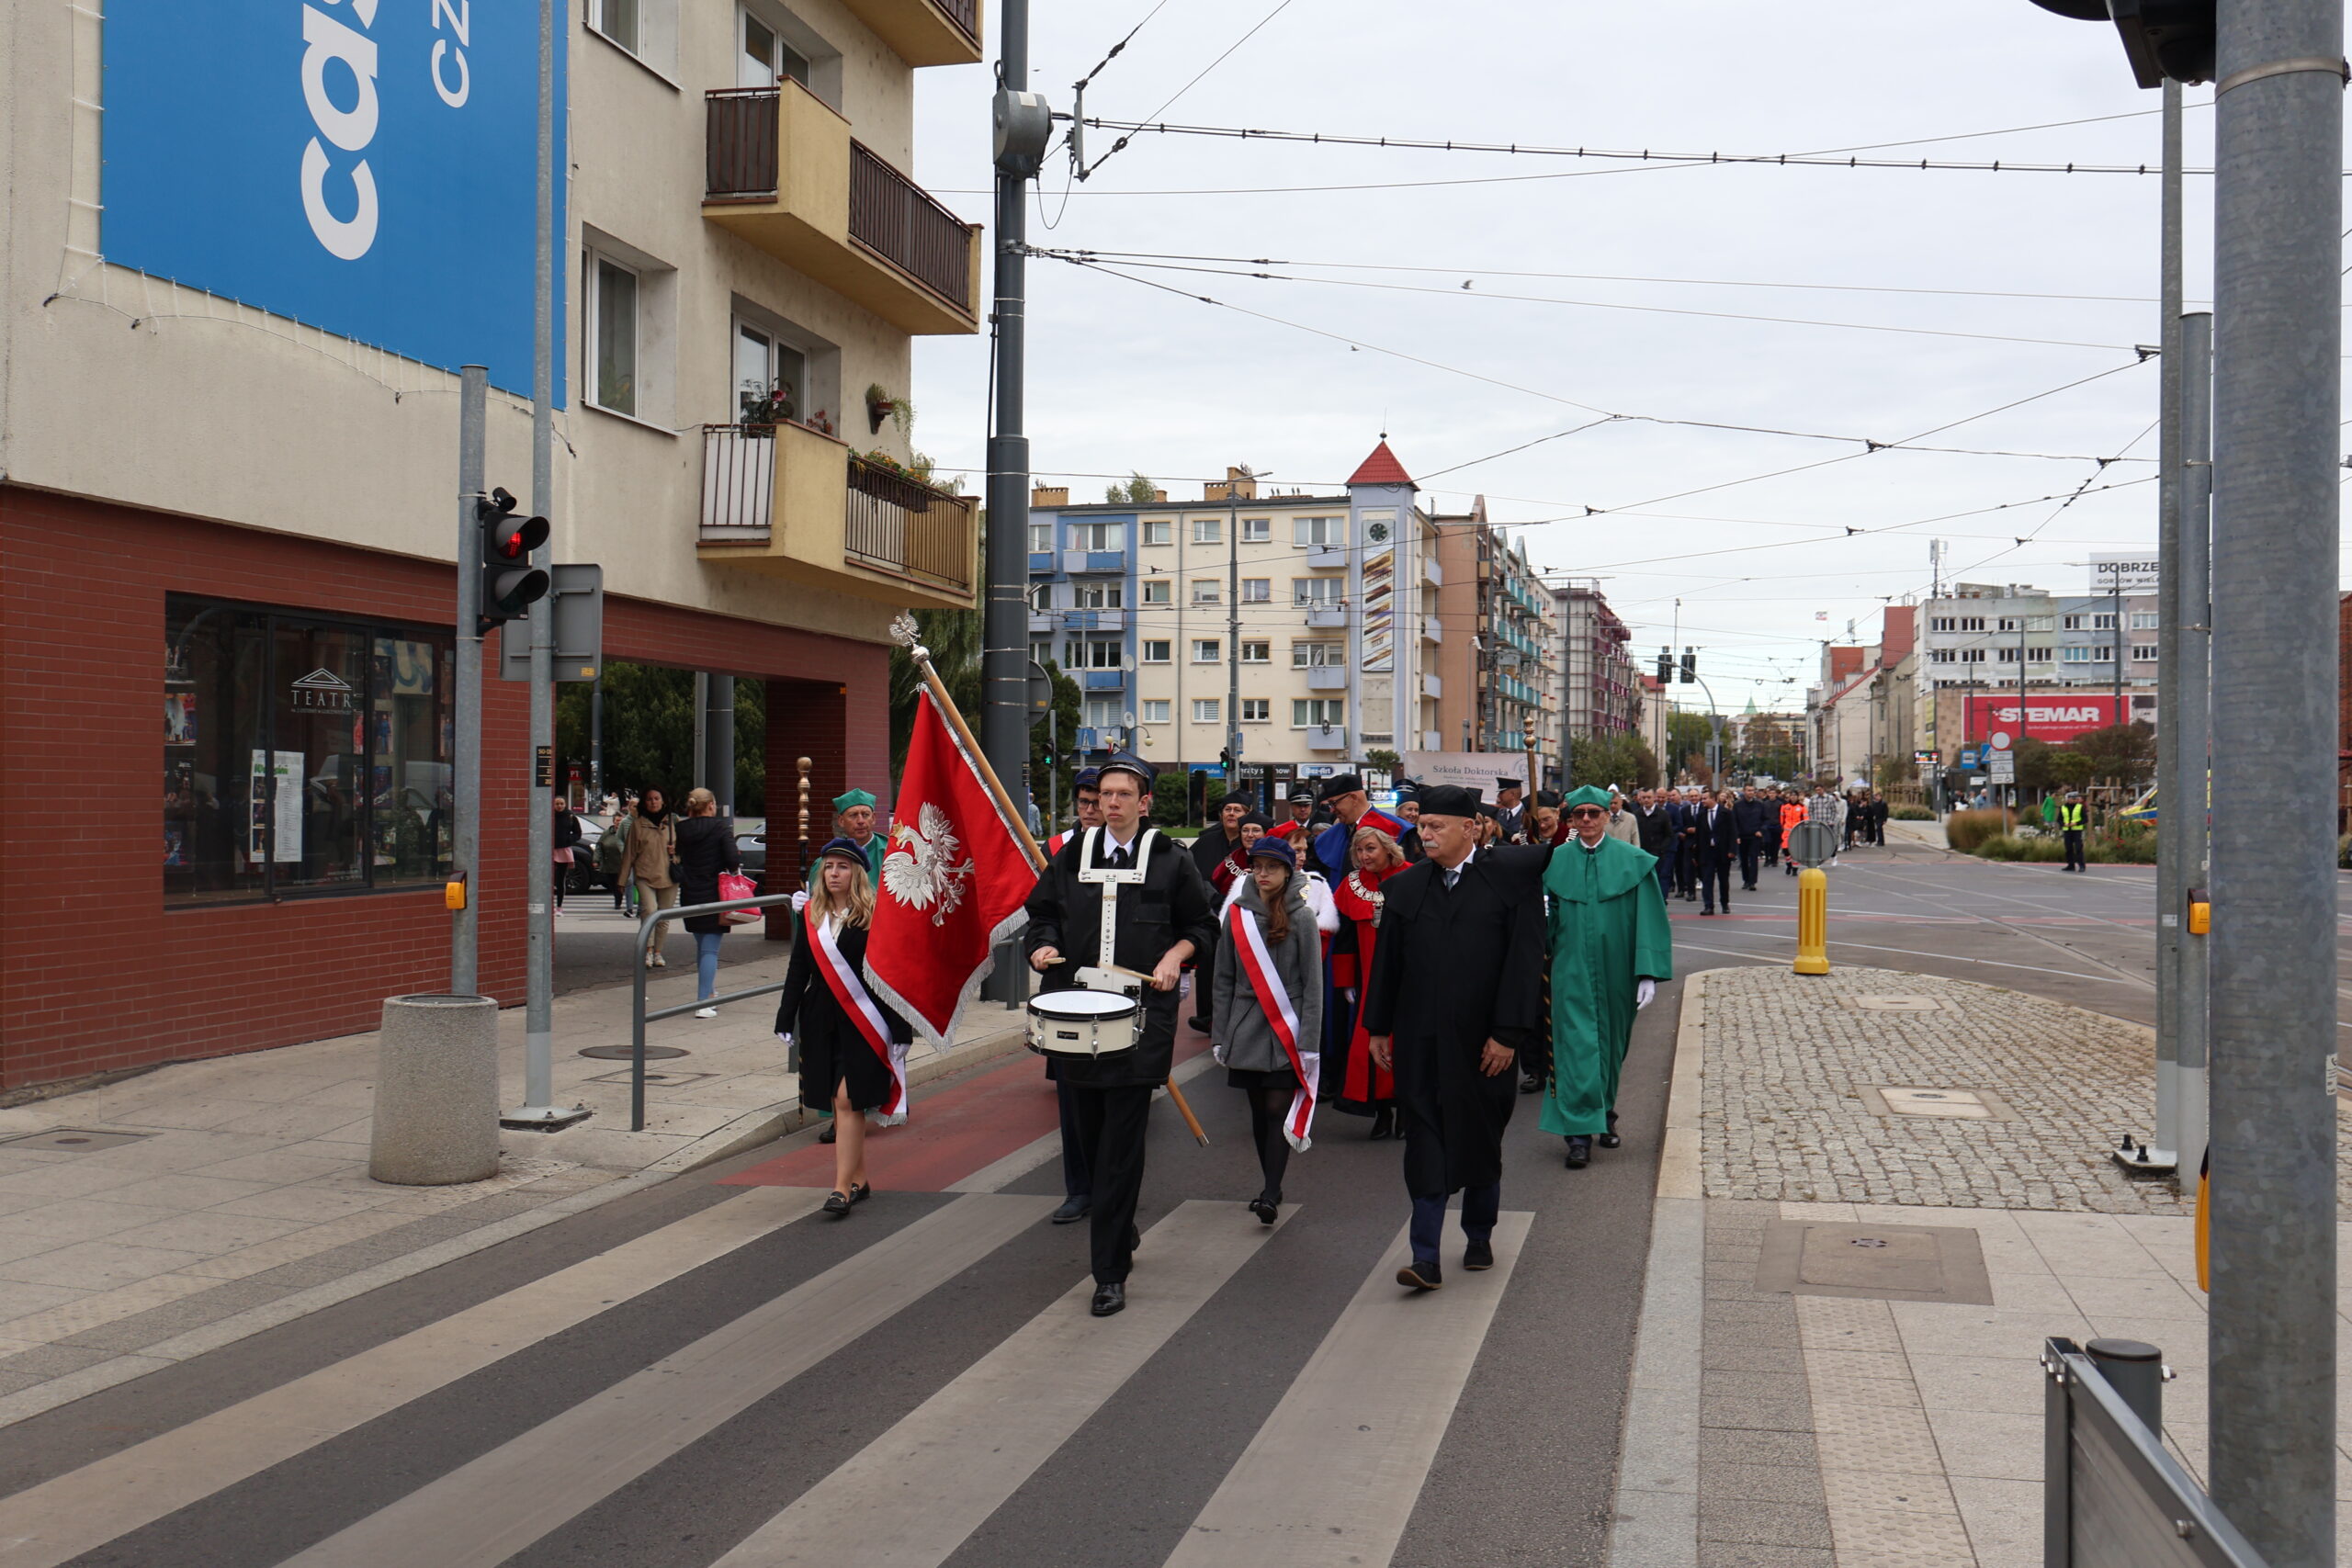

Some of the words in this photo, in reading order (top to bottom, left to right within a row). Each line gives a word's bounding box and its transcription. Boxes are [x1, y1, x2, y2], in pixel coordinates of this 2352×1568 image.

[301, 0, 379, 260] ca
[291, 690, 352, 708] TEATR
[1998, 707, 2099, 722] STEMAR
[1432, 765, 1461, 774] Szkoła
[1464, 766, 1509, 776] Doktorska
